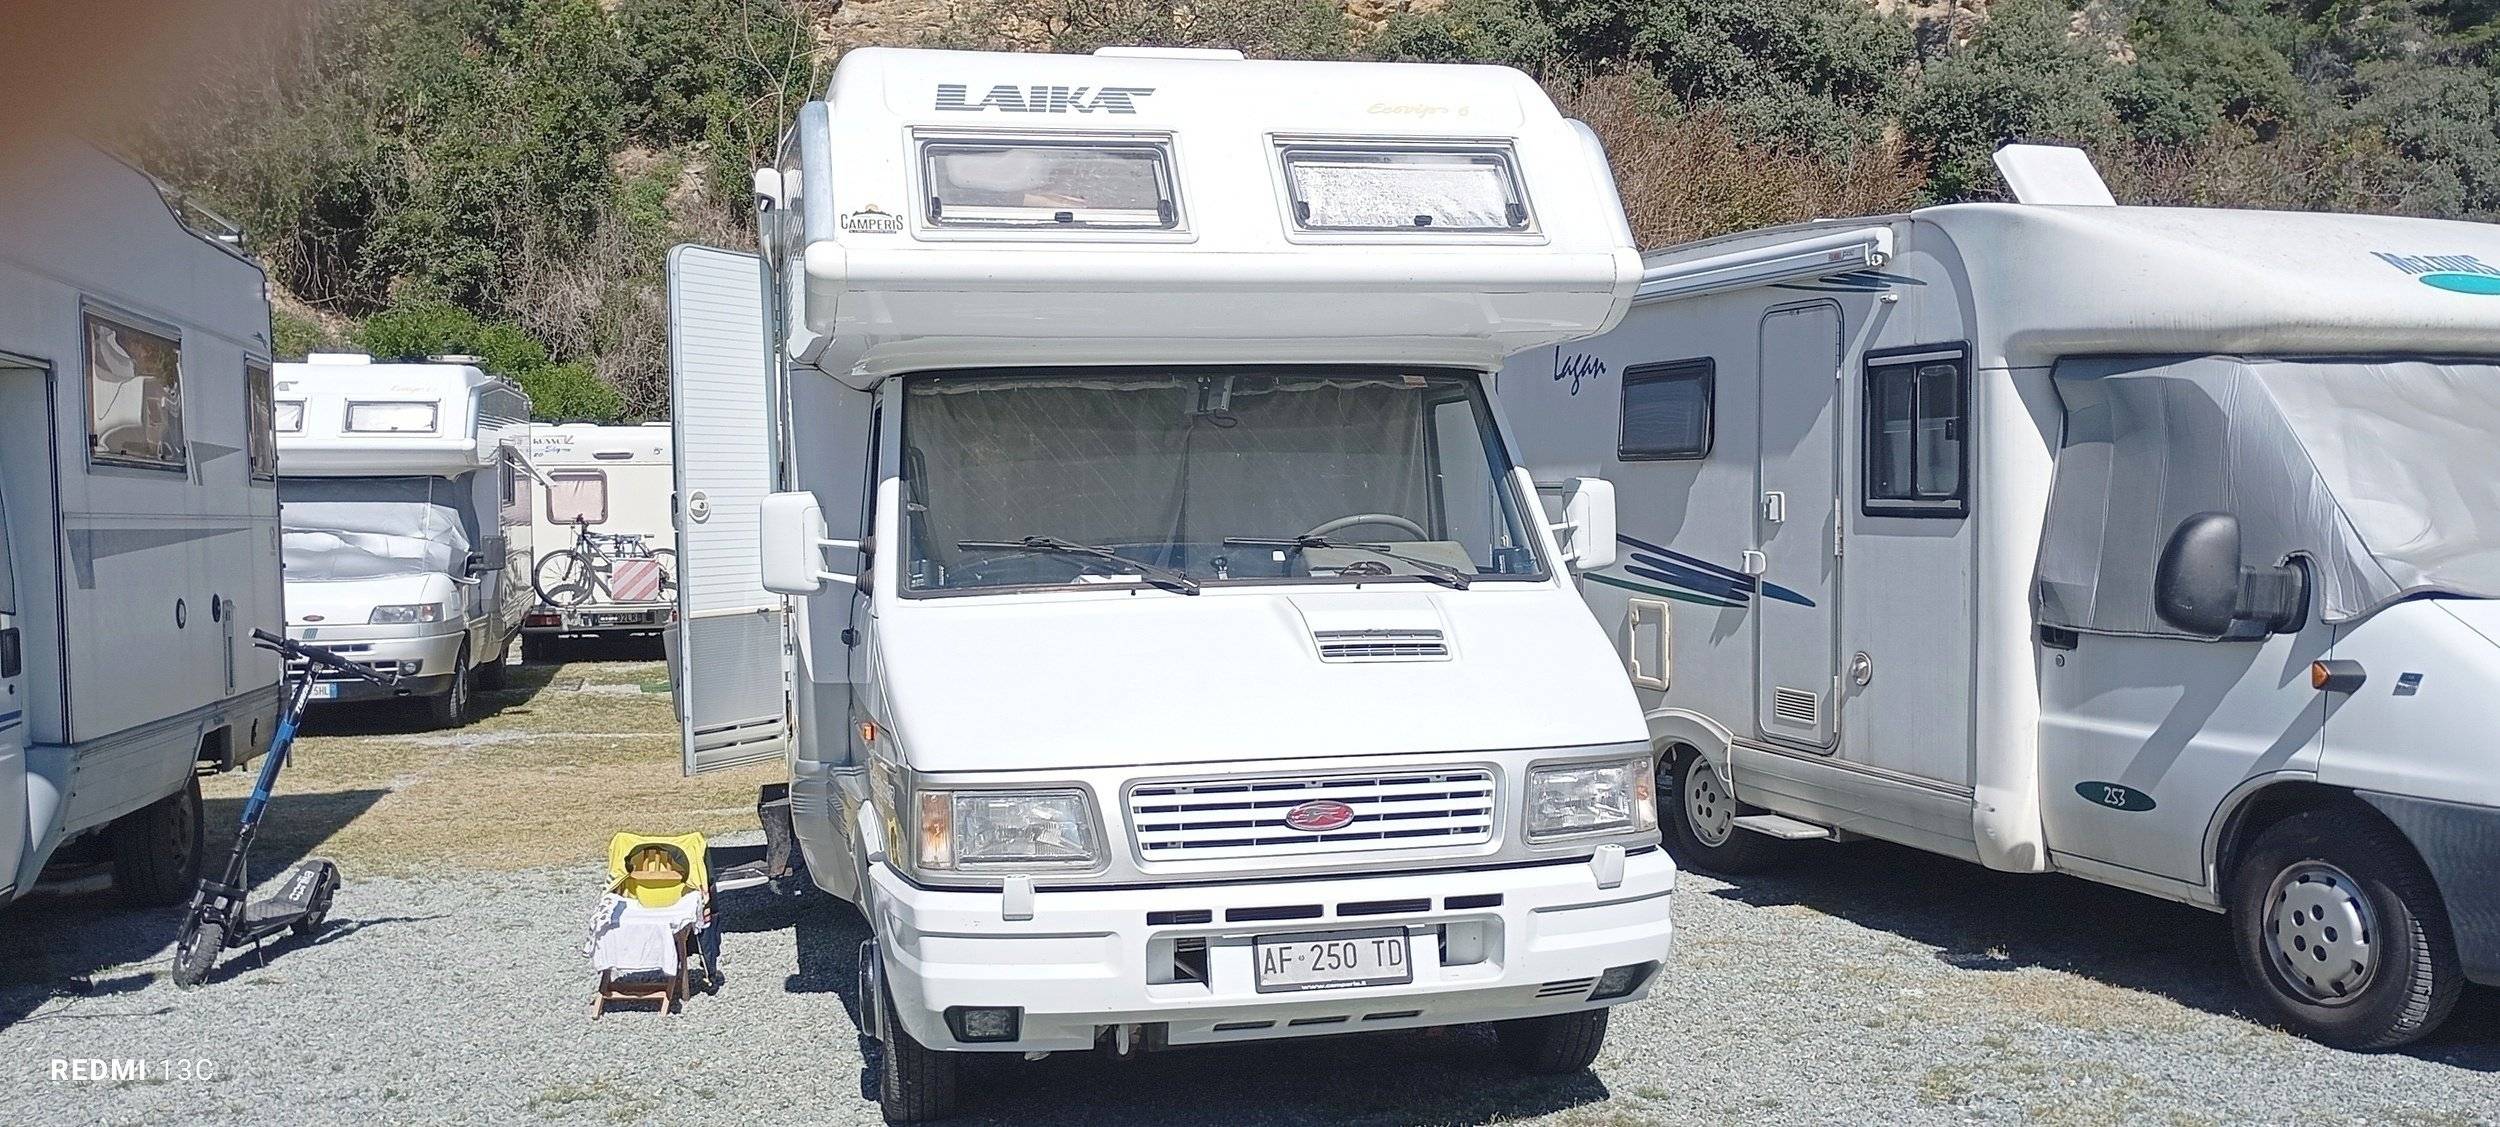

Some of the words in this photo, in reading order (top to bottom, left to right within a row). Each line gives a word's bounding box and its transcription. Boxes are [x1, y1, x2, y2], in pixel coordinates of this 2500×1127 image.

[935, 84, 1156, 114] LAIKA
[841, 213, 904, 230] CAMPERIS
[1554, 345, 1607, 396] Lagan
[2103, 785, 2126, 806] 253
[1264, 946, 1292, 975] AF
[1310, 942, 1358, 971] 250
[1372, 939, 1402, 967] TD
